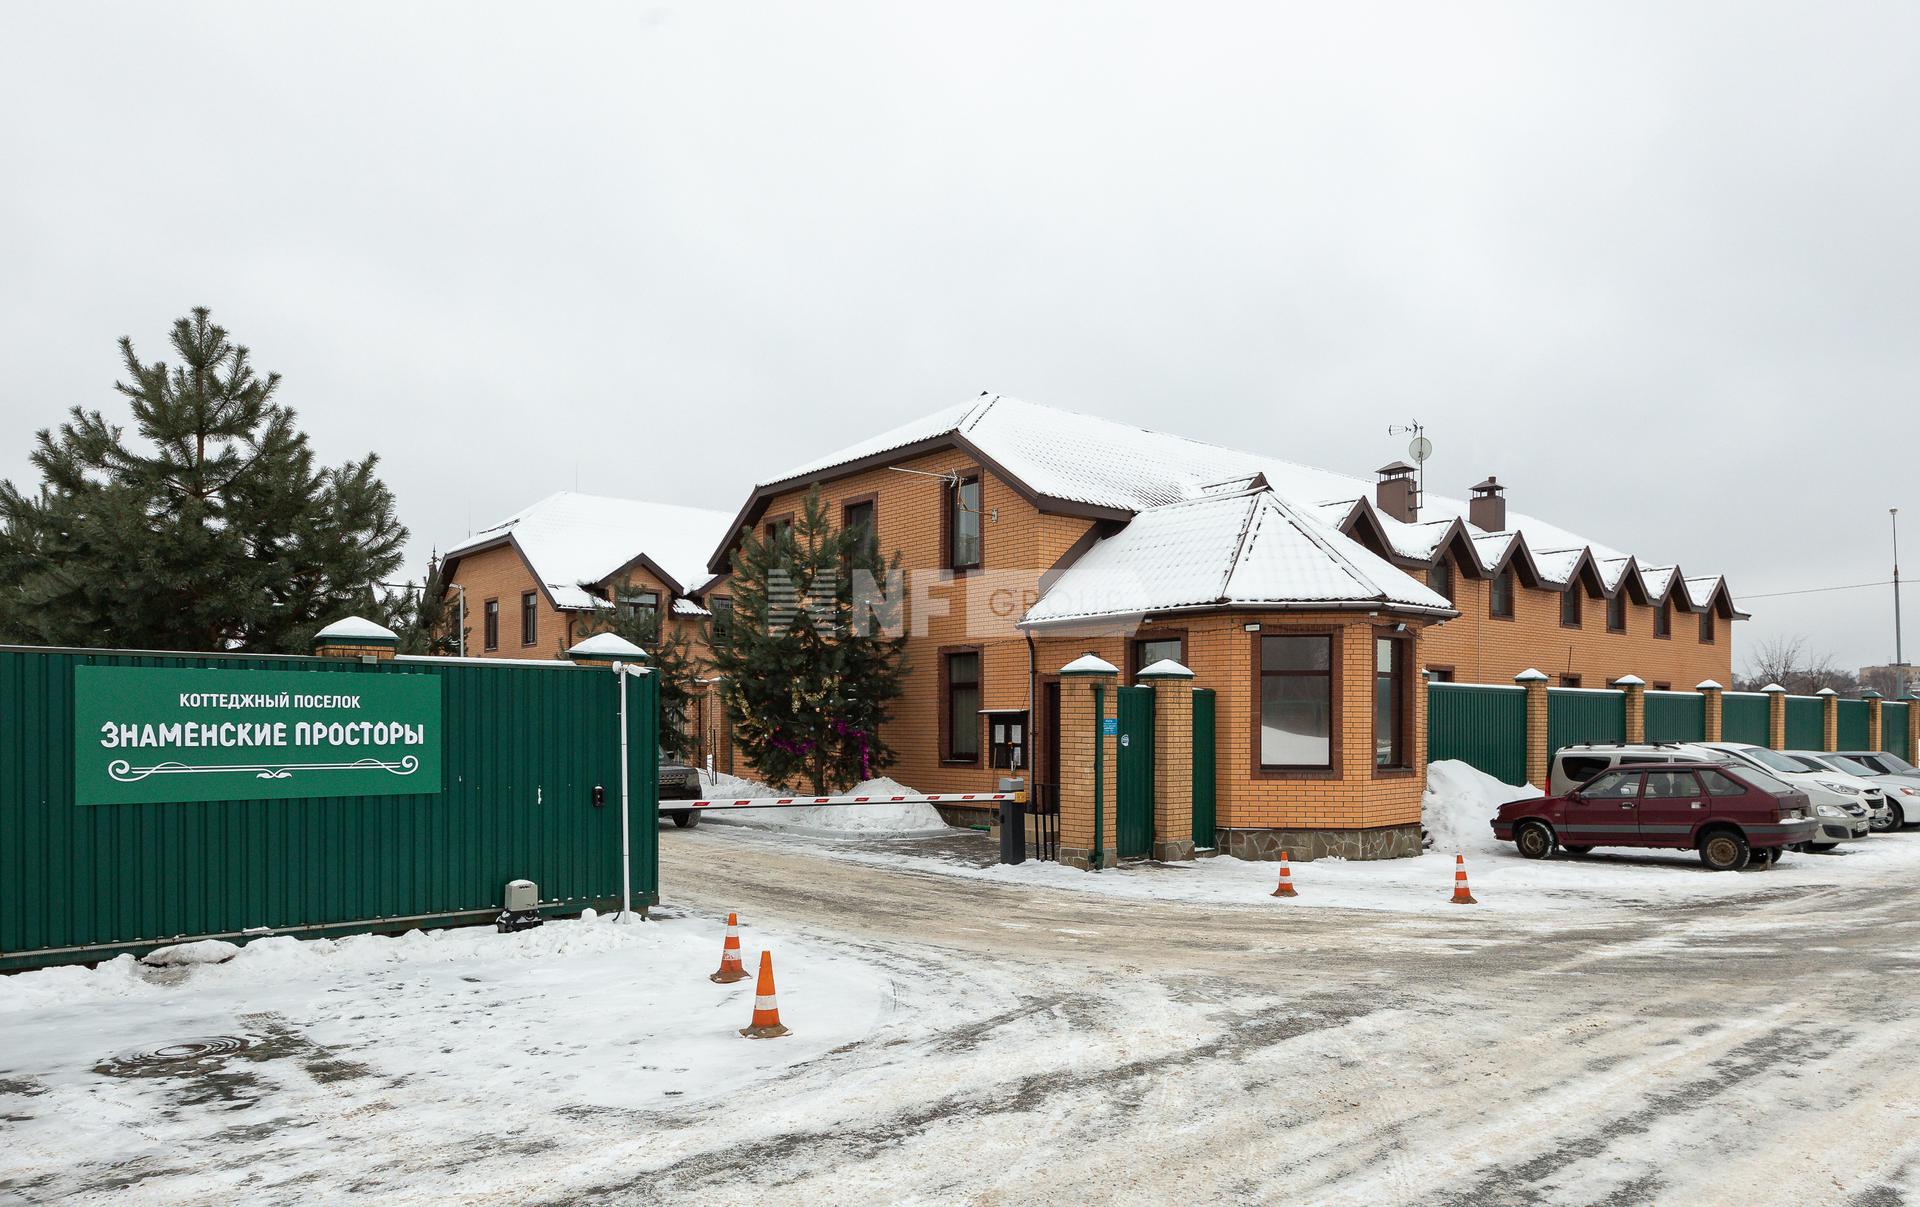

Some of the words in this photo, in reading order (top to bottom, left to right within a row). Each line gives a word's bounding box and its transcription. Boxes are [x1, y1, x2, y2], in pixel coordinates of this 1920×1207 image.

[179, 692, 290, 710] КОТТЕДЖНЫЙ
[294, 694, 361, 709] ПОСЕЛОК
[100, 721, 288, 748] ЗНАМЕНСКИЕ
[295, 721, 425, 746] ПРОСТОРЫ
